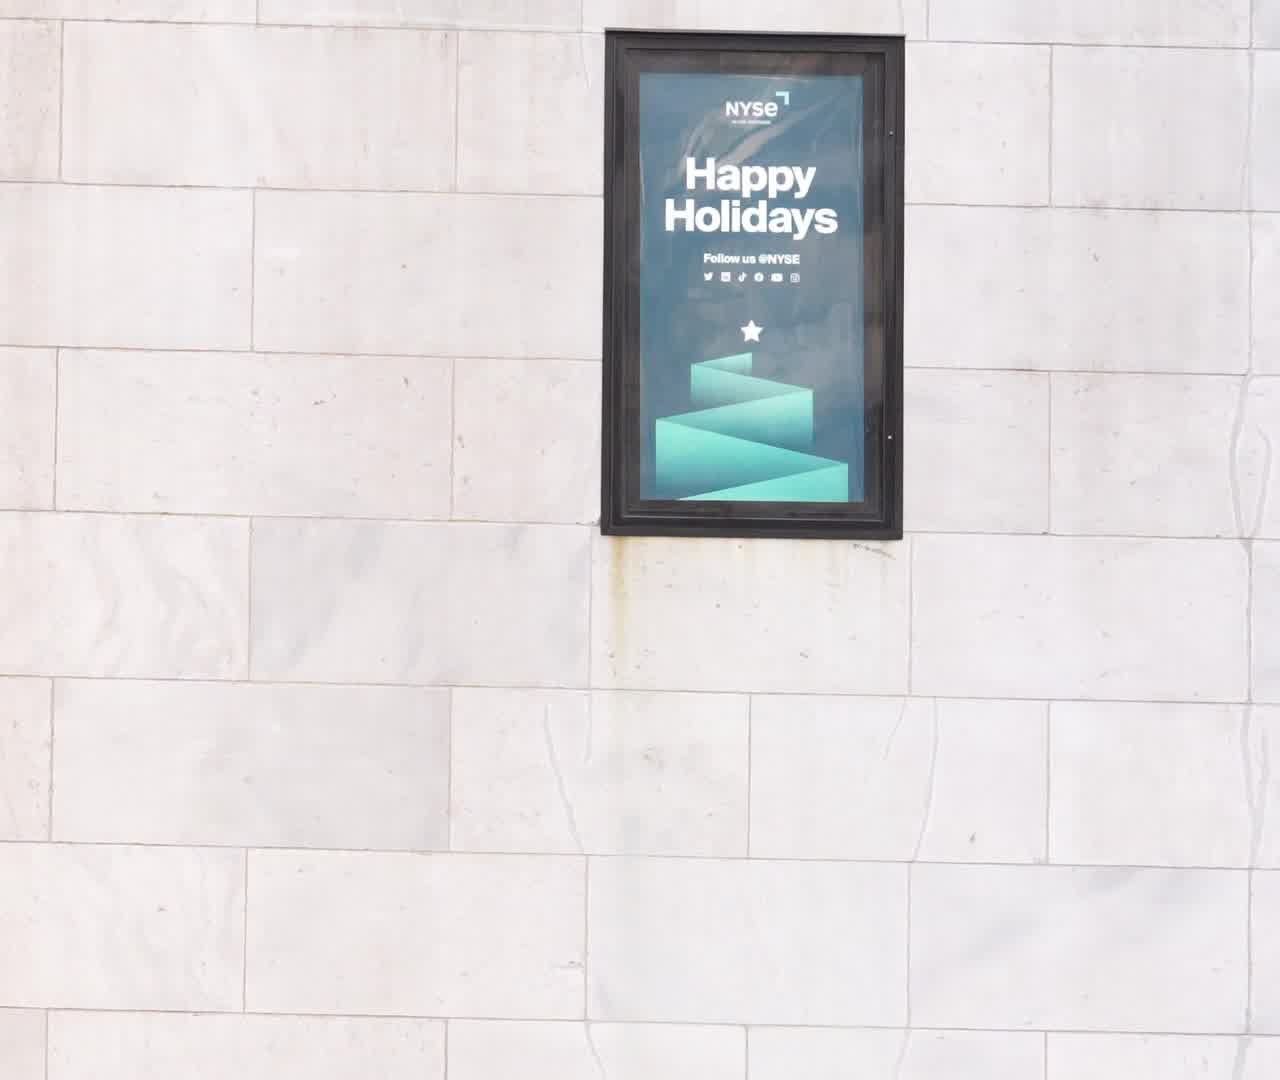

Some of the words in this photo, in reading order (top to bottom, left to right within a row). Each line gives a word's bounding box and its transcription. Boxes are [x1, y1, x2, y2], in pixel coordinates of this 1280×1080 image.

[686, 157, 817, 199] Happy
[665, 198, 839, 240] Holidays
[703, 253, 740, 264] Follow
[742, 254, 757, 264] us
[758, 254, 801, 265] @NYSE
